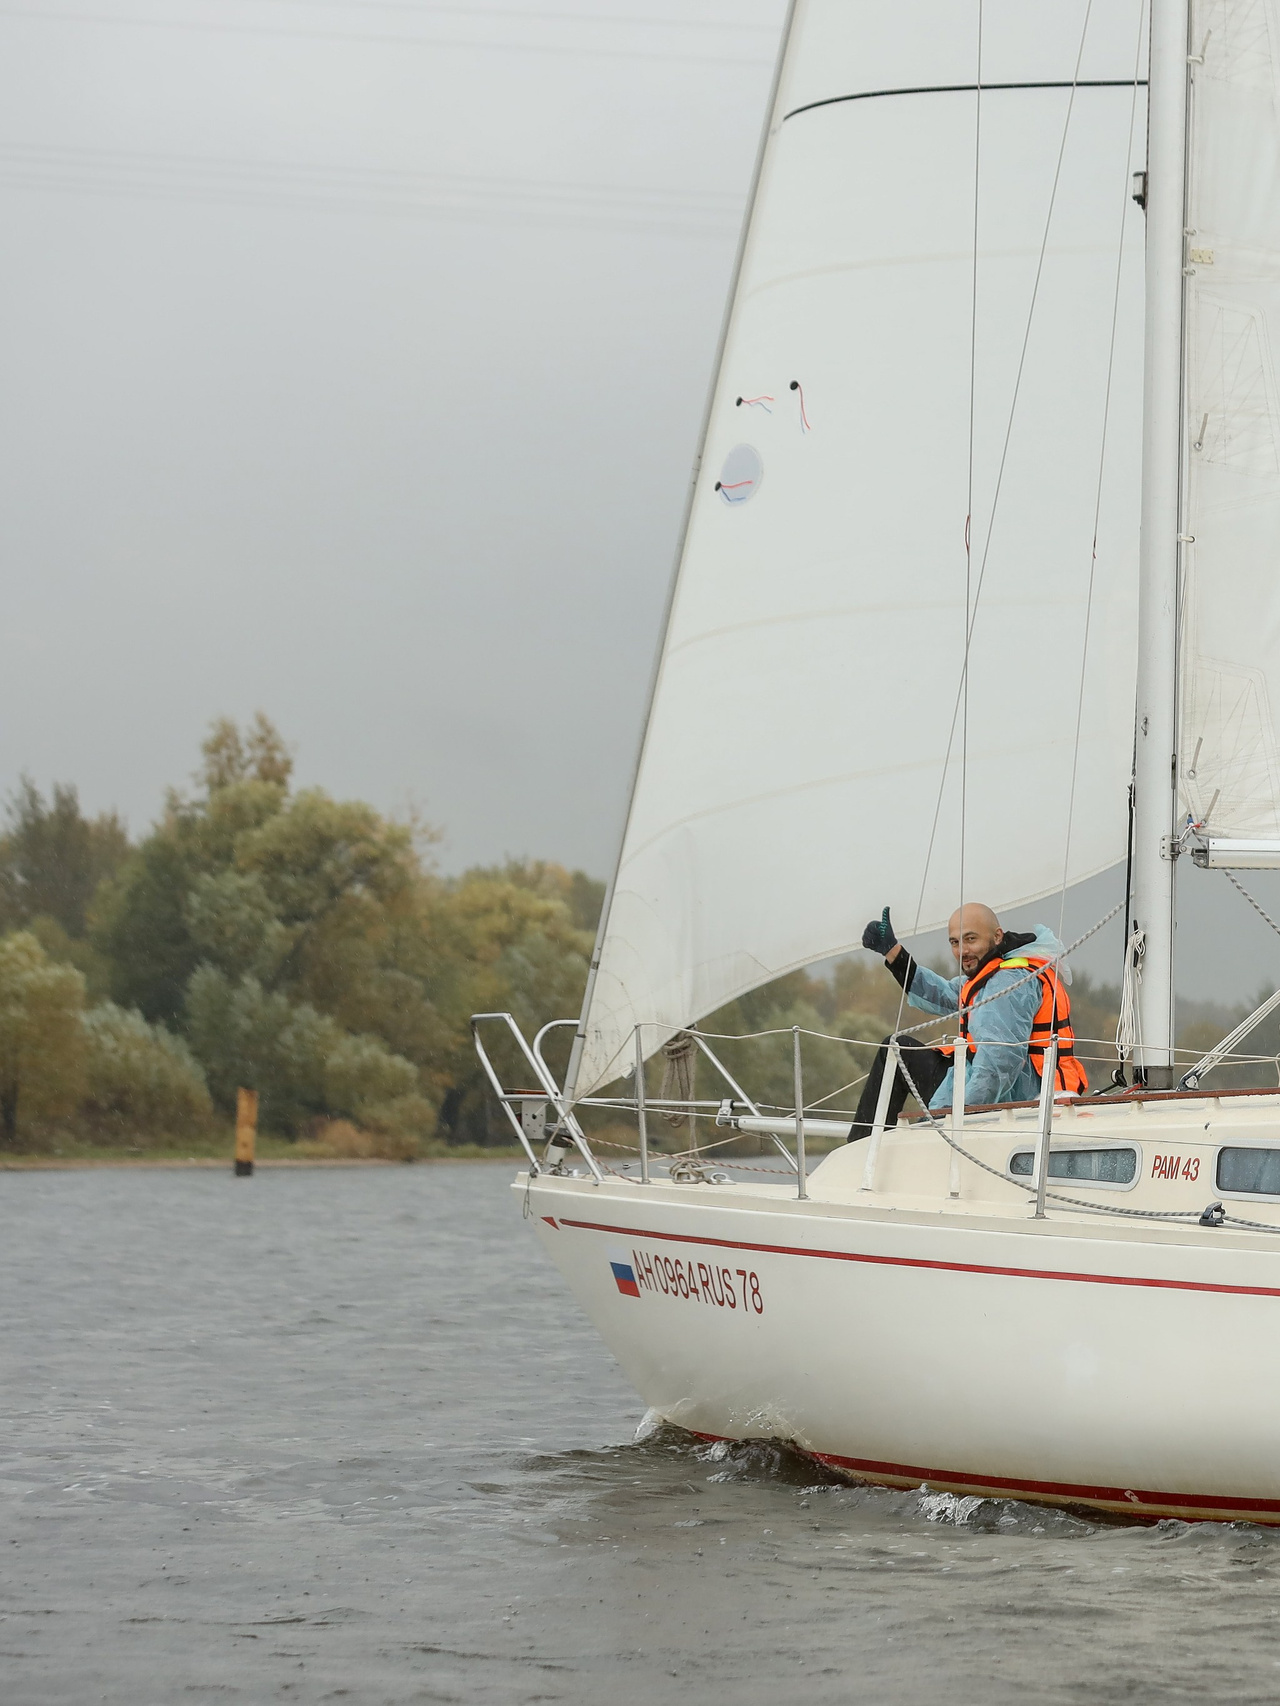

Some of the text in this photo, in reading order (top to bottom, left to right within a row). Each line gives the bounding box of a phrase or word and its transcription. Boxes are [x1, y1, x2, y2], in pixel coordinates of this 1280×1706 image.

[1151, 1155, 1200, 1181] PAM 43
[736, 1269, 763, 1314] 78
